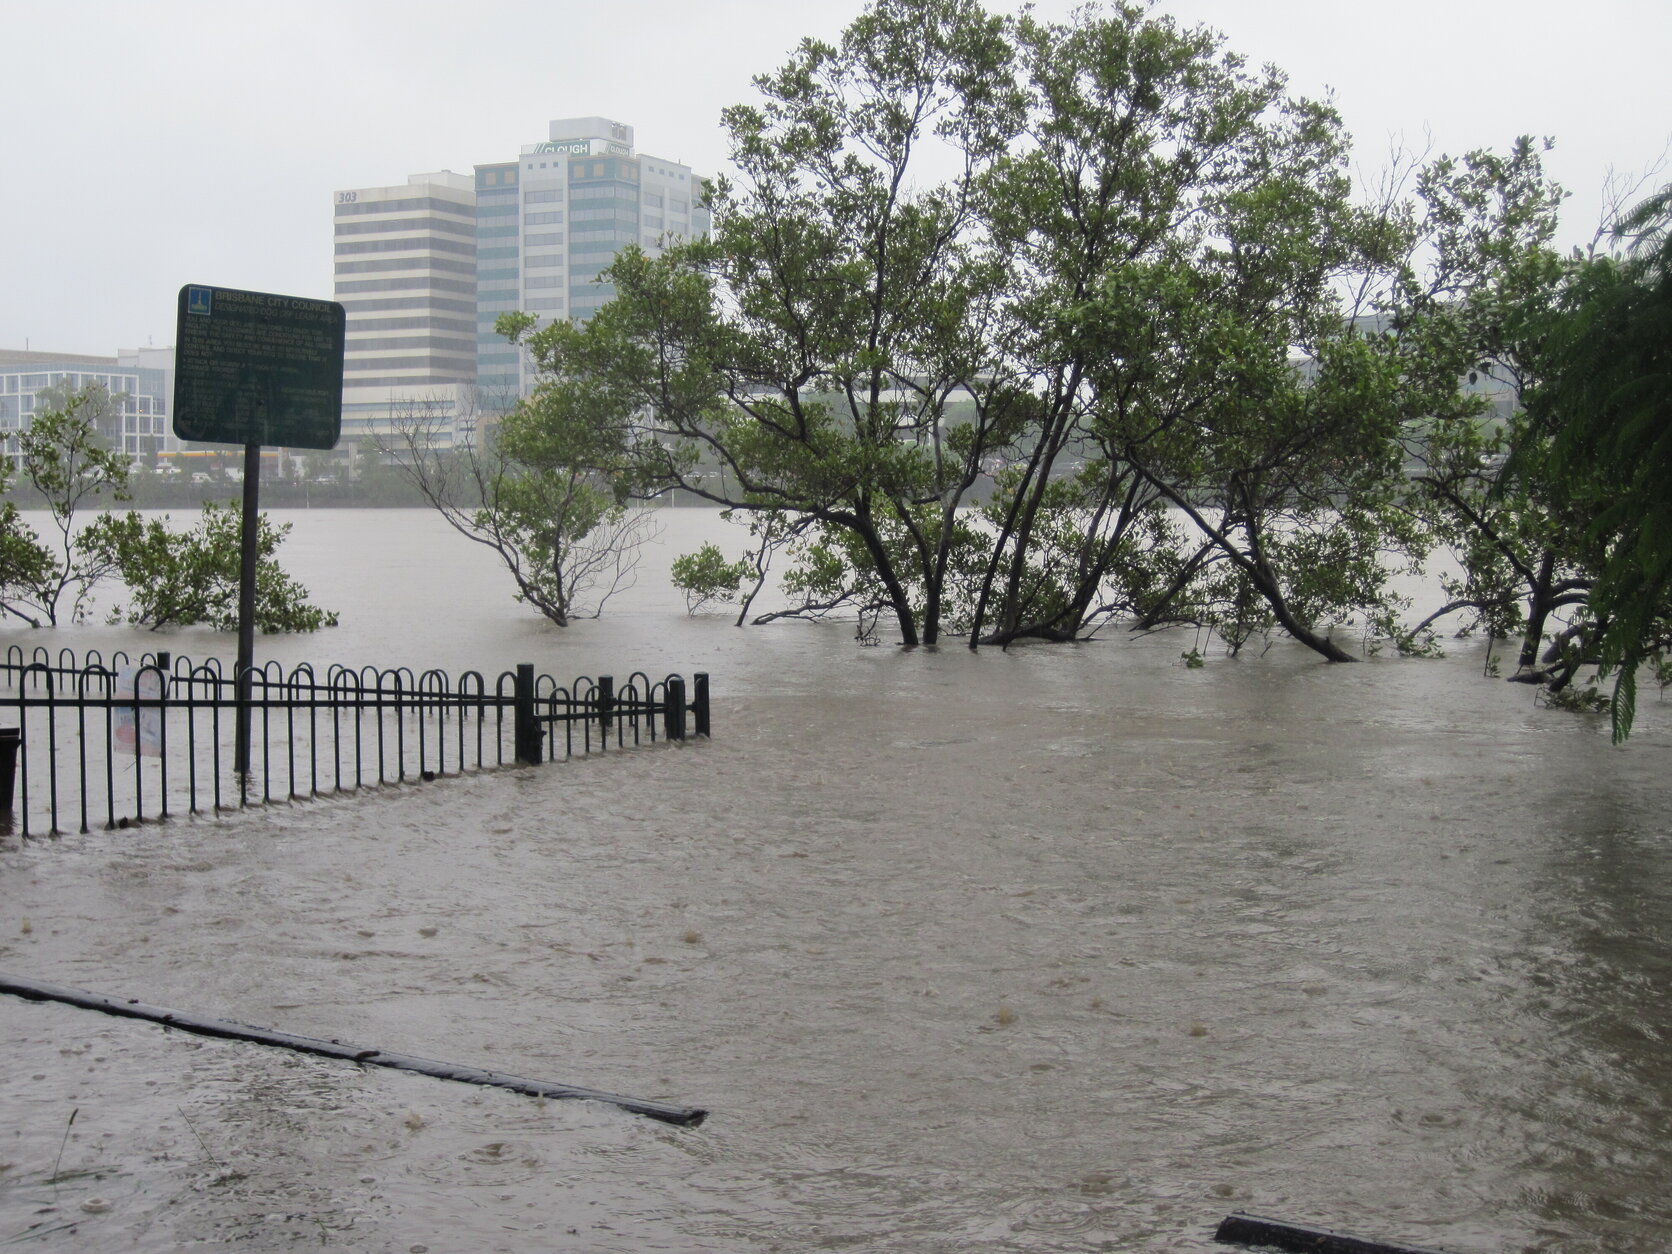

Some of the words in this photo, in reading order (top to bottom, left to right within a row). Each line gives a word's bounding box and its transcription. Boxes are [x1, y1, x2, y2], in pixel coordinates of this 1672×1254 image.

[338, 192, 358, 203] 303
[215, 291, 264, 304] BRISBANE
[267, 297, 288, 307] CITY
[291, 300, 331, 312] COUNCIL
[214, 302, 258, 314] DESIGNATED
[260, 307, 277, 316] DOG
[295, 311, 317, 321] LEASH
[319, 314, 337, 323] AREA
